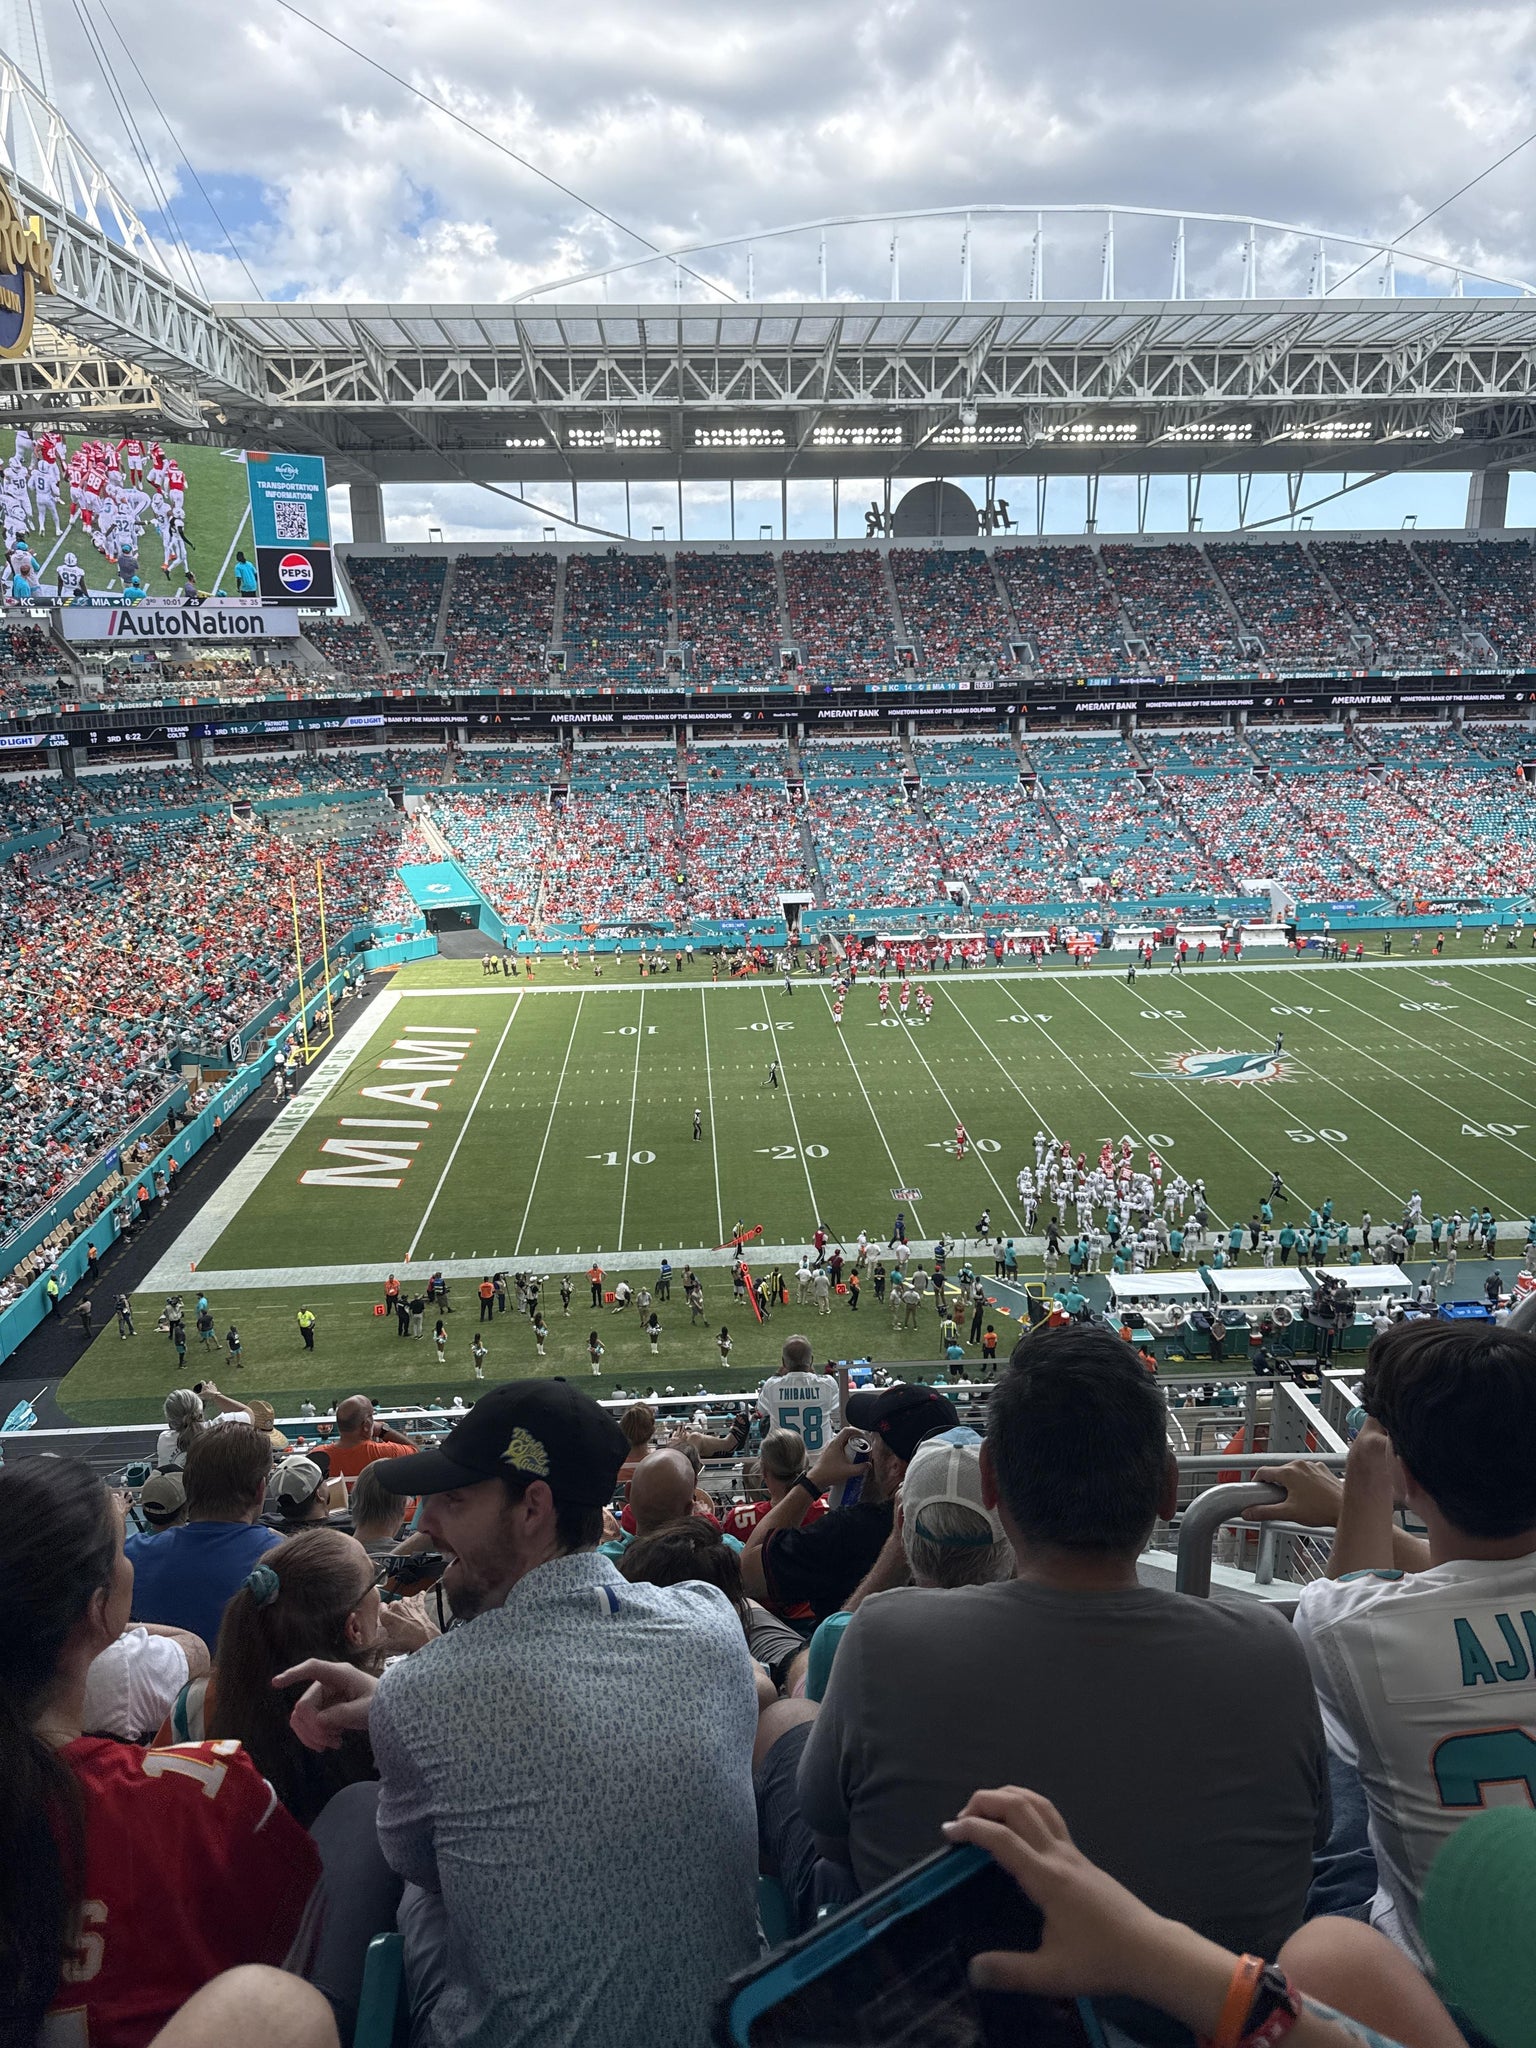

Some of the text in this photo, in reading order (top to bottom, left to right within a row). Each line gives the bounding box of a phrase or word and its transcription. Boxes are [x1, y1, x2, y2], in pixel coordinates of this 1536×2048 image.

[256, 481, 319, 491] TRANSPORTATION
[265, 490, 313, 500] INFORMATION
[61, 572, 78, 586] 93
[281, 569, 311, 578] PEPSI
[20, 598, 35, 606] KC
[51, 598, 63, 606] 14
[91, 598, 110, 606] MIA
[120, 598, 132, 606] 10
[118, 610, 264, 636] AutoNation
[889, 684, 899, 692] KC
[1331, 696, 1392, 704] AMERANT BANK
[1075, 702, 1137, 711] AMERANT BANK
[550, 714, 614, 723] AMERANT BANK
[818, 710, 858, 718] AMERANT
[230, 726, 249, 734] 11:33
[9, 737, 33, 745] LIGHT
[107, 733, 141, 743] 3RD 6:22
[1139, 1009, 1188, 1020] 50
[1270, 1005, 1314, 1016] 40
[880, 1017, 926, 1028] 30
[1009, 1012, 1053, 1024] 40
[618, 1025, 660, 1036] 10
[750, 1021, 795, 1032] 20
[330, 1049, 356, 1061] US
[318, 1064, 344, 1076] OF
[223, 1083, 249, 1114] Dolphins
[297, 1025, 480, 1188] MIAMI
[267, 1101, 316, 1138] TAKES
[1284, 1128, 1348, 1144] 50
[1461, 1123, 1518, 1138] 40
[252, 1143, 283, 1155] IT
[771, 1144, 830, 1160] 20
[602, 1150, 657, 1166] 10
[606, 1293, 614, 1302] 10
[778, 1387, 821, 1401] THIBAULT
[778, 1406, 823, 1451] 58
